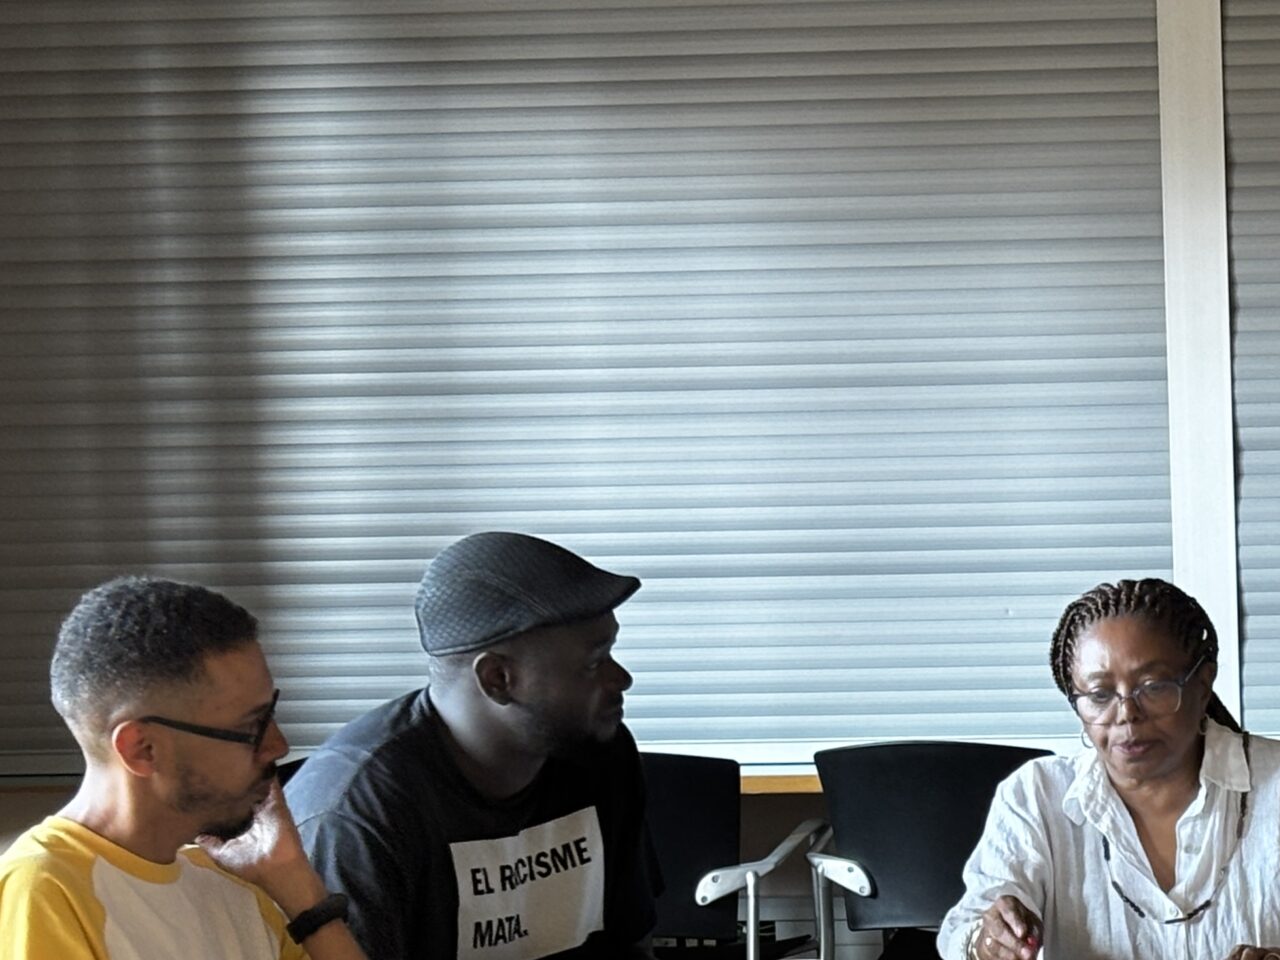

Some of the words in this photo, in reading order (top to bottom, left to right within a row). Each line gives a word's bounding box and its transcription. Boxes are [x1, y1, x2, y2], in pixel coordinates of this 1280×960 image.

[470, 867, 495, 896] EL
[500, 836, 592, 892] RCISME
[473, 913, 529, 949] MATA.
